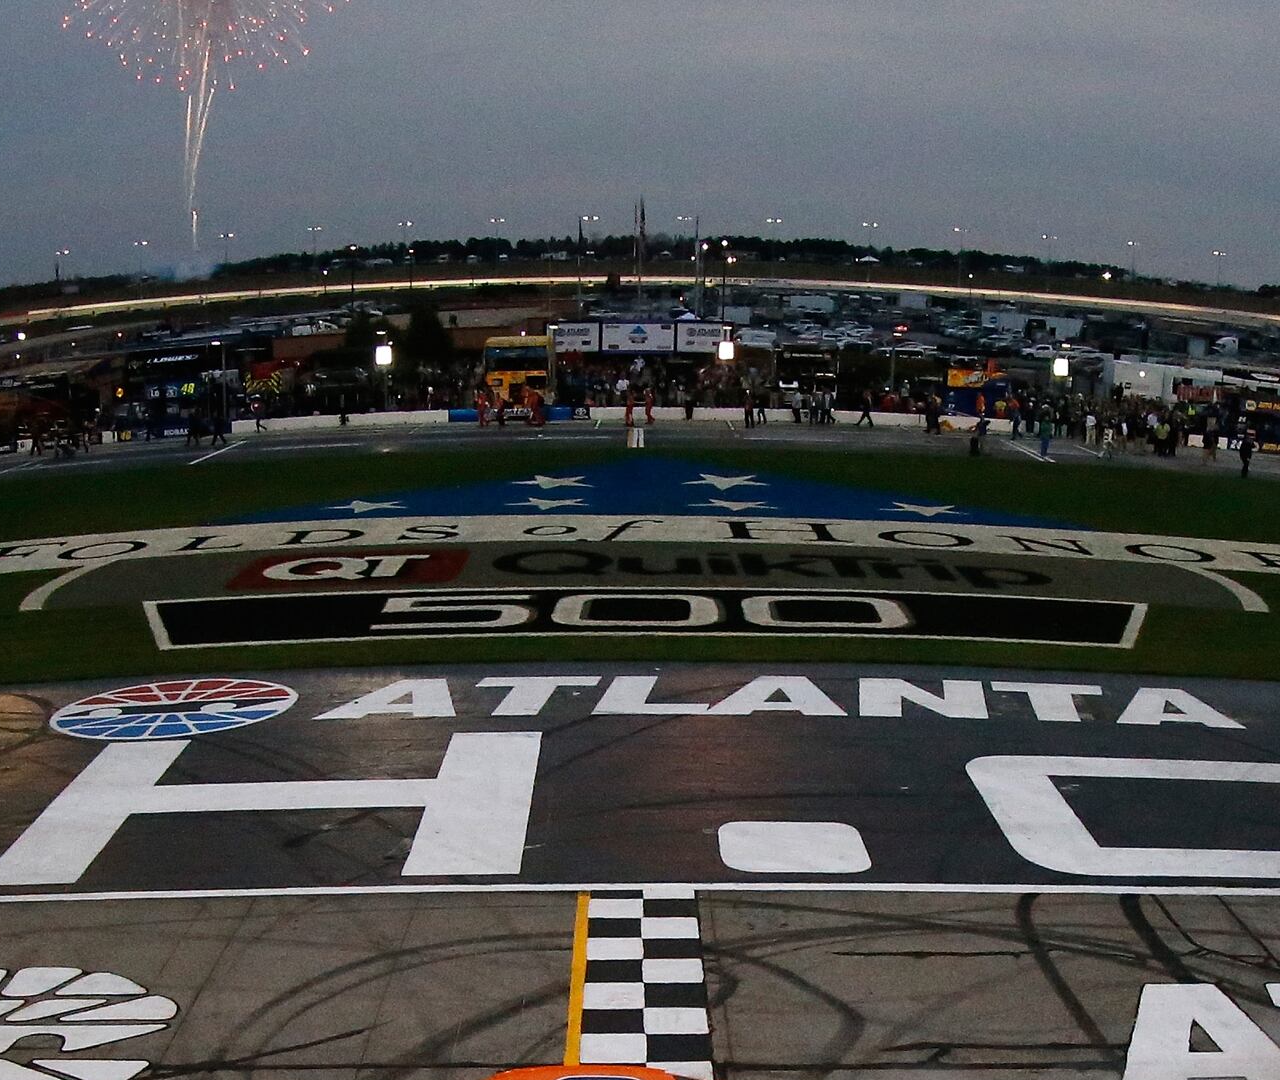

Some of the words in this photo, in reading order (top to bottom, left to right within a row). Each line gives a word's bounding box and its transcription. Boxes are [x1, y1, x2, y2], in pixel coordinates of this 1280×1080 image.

[522, 519, 665, 542] of
[261, 554, 431, 583] QT
[492, 548, 1053, 590] QuikTrip
[370, 595, 915, 632] 500
[312, 675, 1247, 731] ATLANTA
